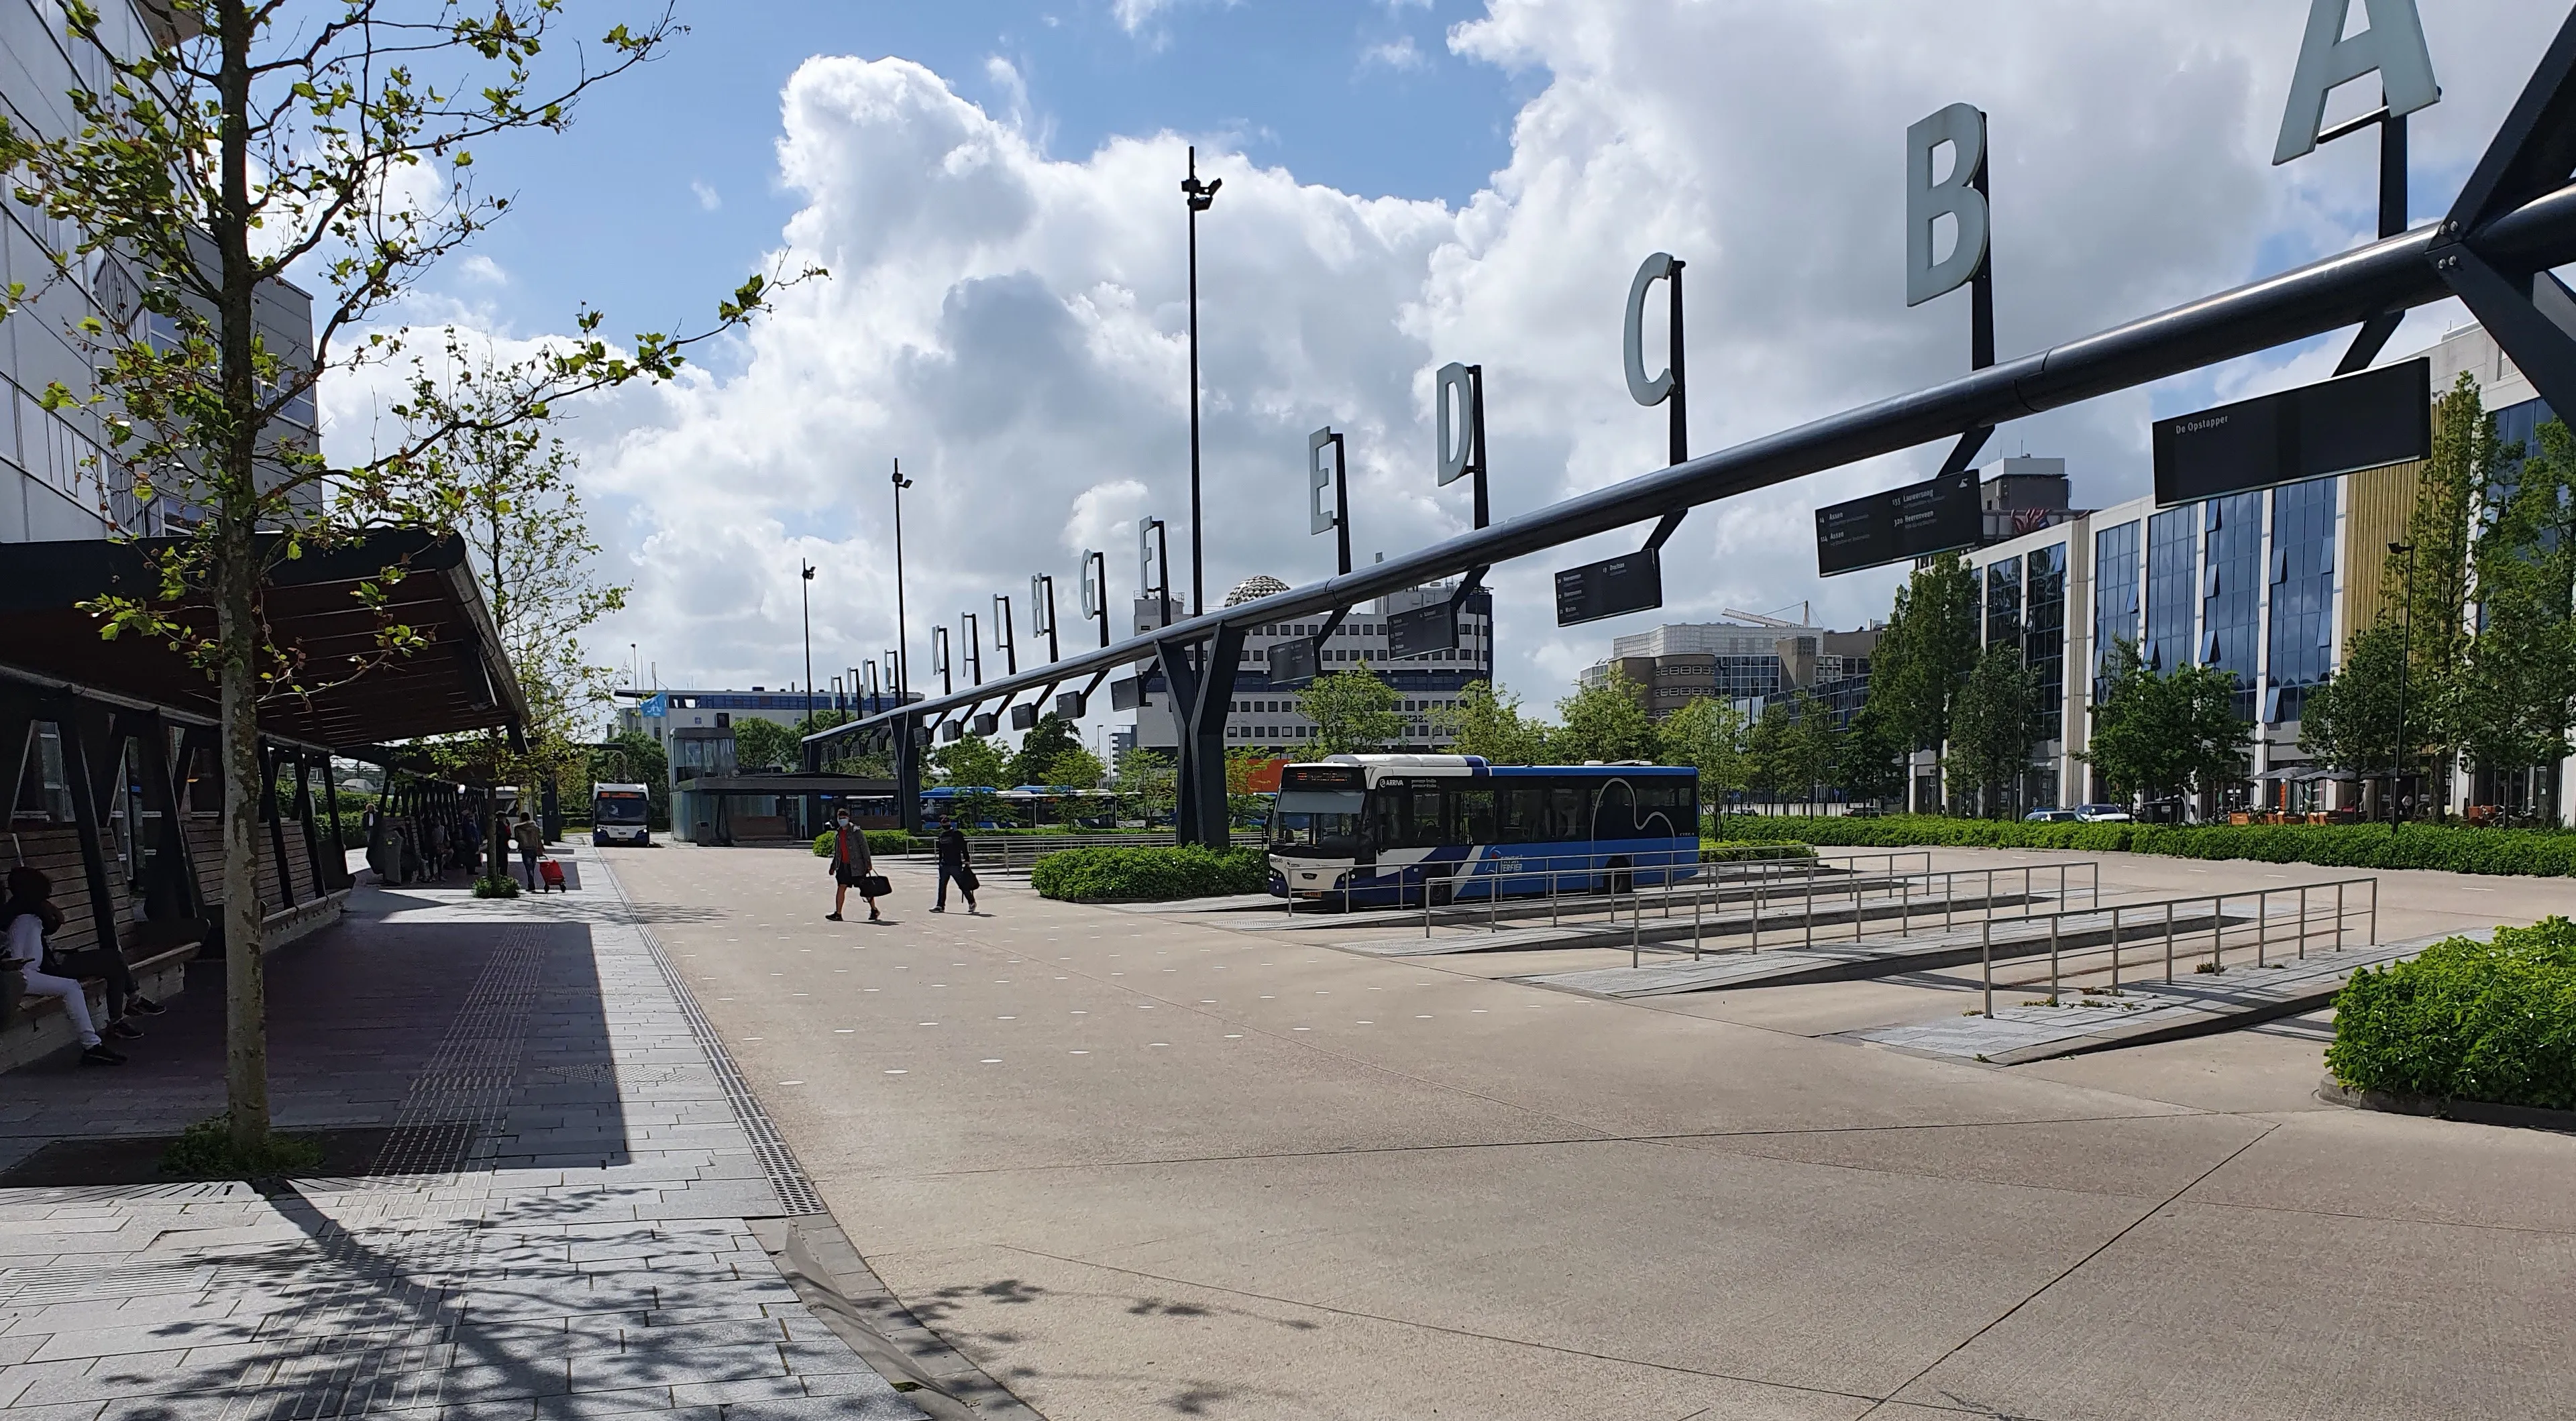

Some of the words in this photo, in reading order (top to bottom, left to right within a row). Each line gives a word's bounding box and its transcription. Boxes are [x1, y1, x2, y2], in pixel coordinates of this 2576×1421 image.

[2273, 0, 2440, 166] A
[1907, 102, 1989, 308] B
[1623, 251, 1676, 407] C
[1436, 362, 1473, 487] D
[2176, 424, 2186, 435] De
[2188, 415, 2229, 433] Opstapper
[1309, 426, 1334, 535] E
[1030, 572, 1044, 638] H
[1081, 549, 1095, 620] G
[1139, 516, 1152, 598] F
